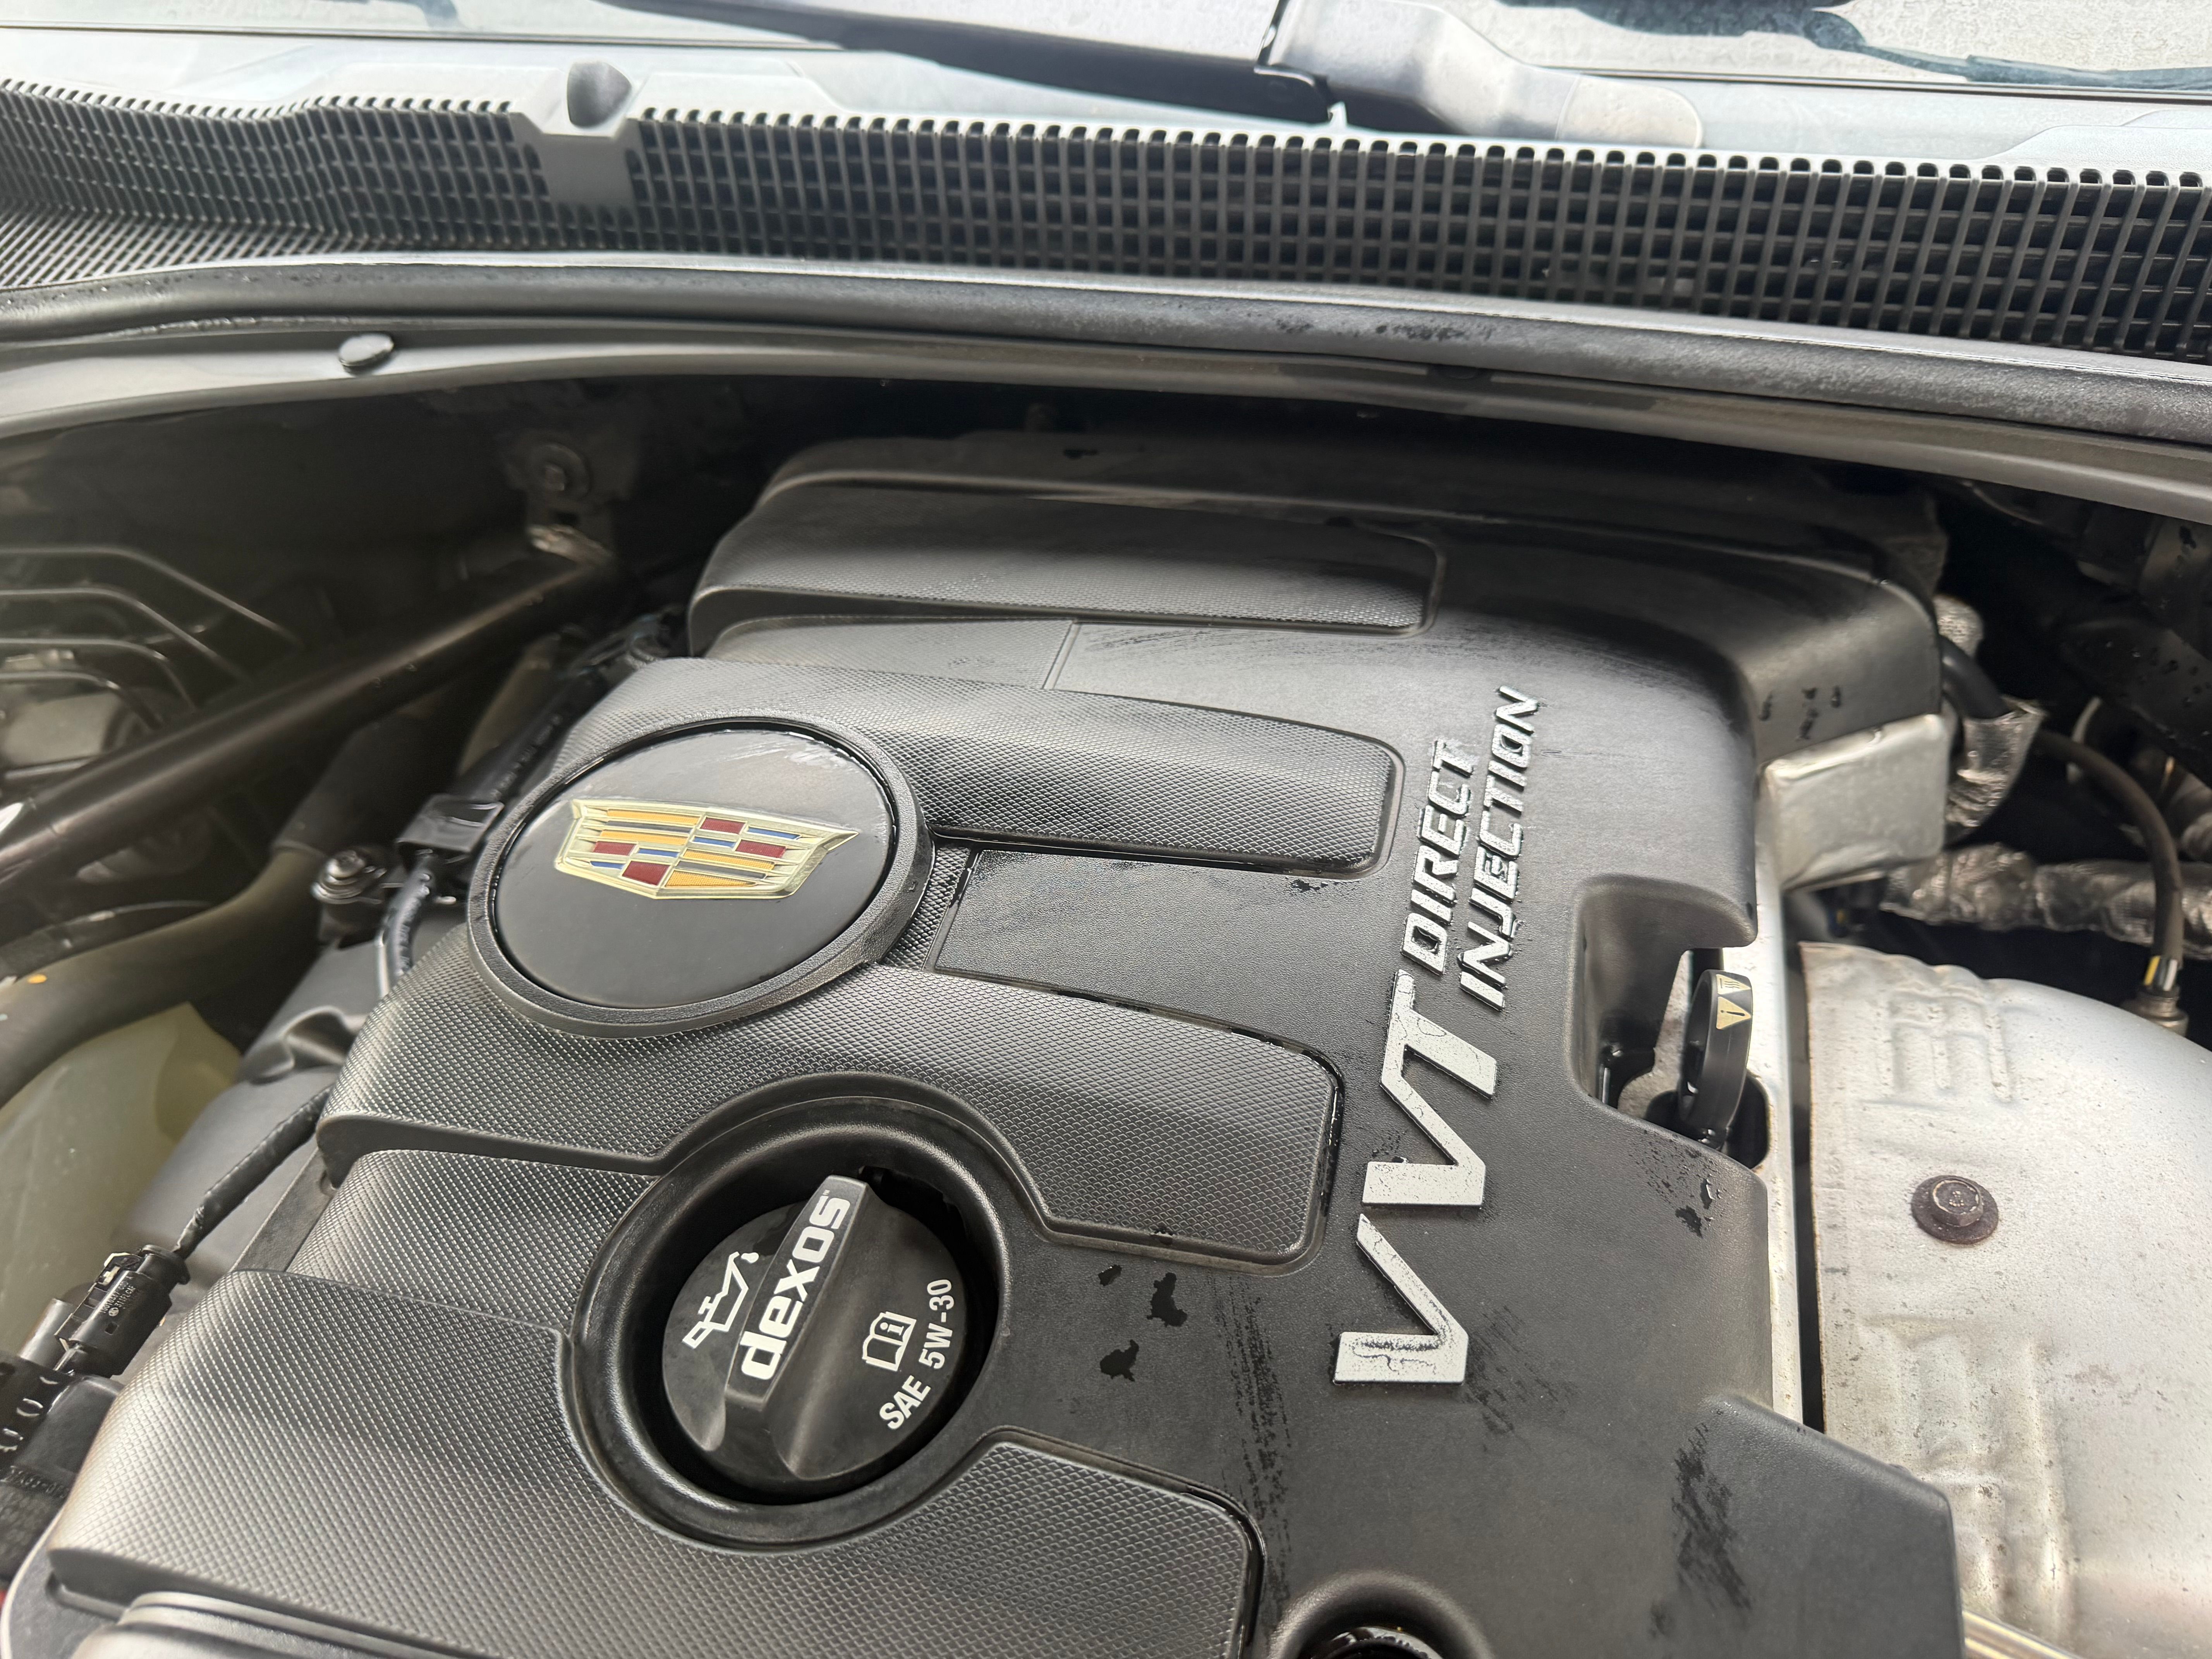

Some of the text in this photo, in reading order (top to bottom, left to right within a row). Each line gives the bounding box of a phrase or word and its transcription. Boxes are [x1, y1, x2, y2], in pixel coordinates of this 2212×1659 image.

[1401, 738, 1473, 975] DIRECT
[1458, 685, 1539, 1011] INJECTION
[739, 1195, 850, 1380] dexos
[1334, 969, 1497, 1385] VVT
[879, 1279, 954, 1430] SAE 5W-30
